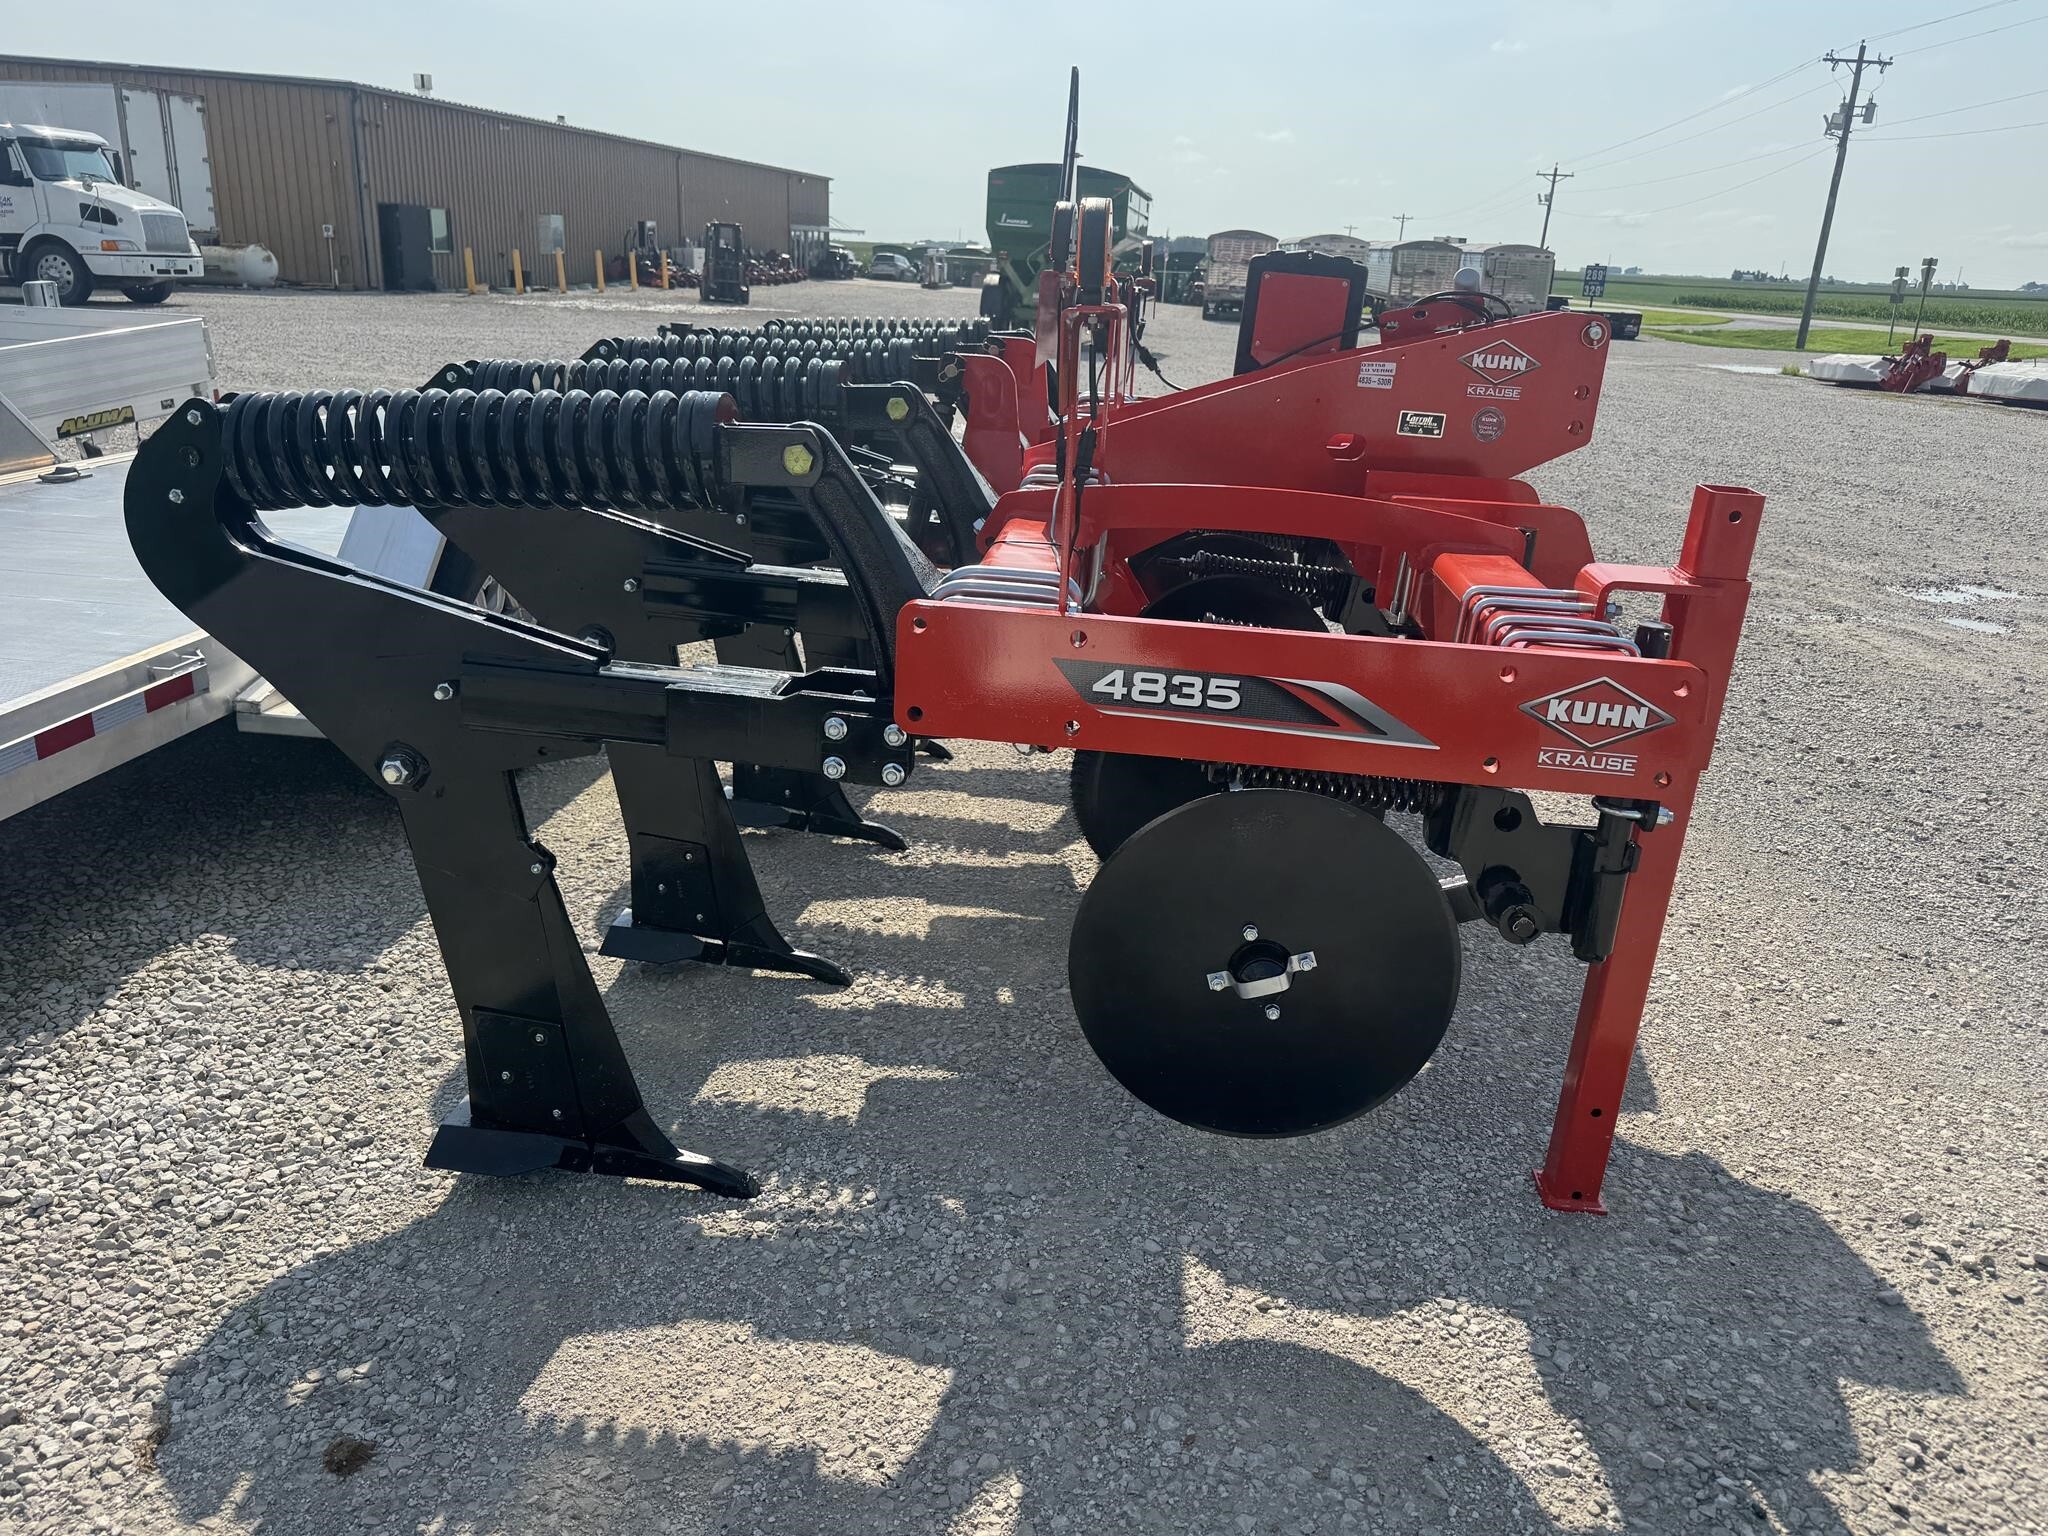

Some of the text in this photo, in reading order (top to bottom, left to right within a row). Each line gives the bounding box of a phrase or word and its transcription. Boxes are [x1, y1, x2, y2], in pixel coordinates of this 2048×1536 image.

[1472, 353, 1528, 371] KUHN
[1467, 386, 1522, 398] KRAUSE
[58, 405, 135, 437] ALUMA
[1092, 669, 1241, 710] 4835
[1546, 698, 1649, 729] KUHN
[1538, 751, 1638, 772] KRAUSE
